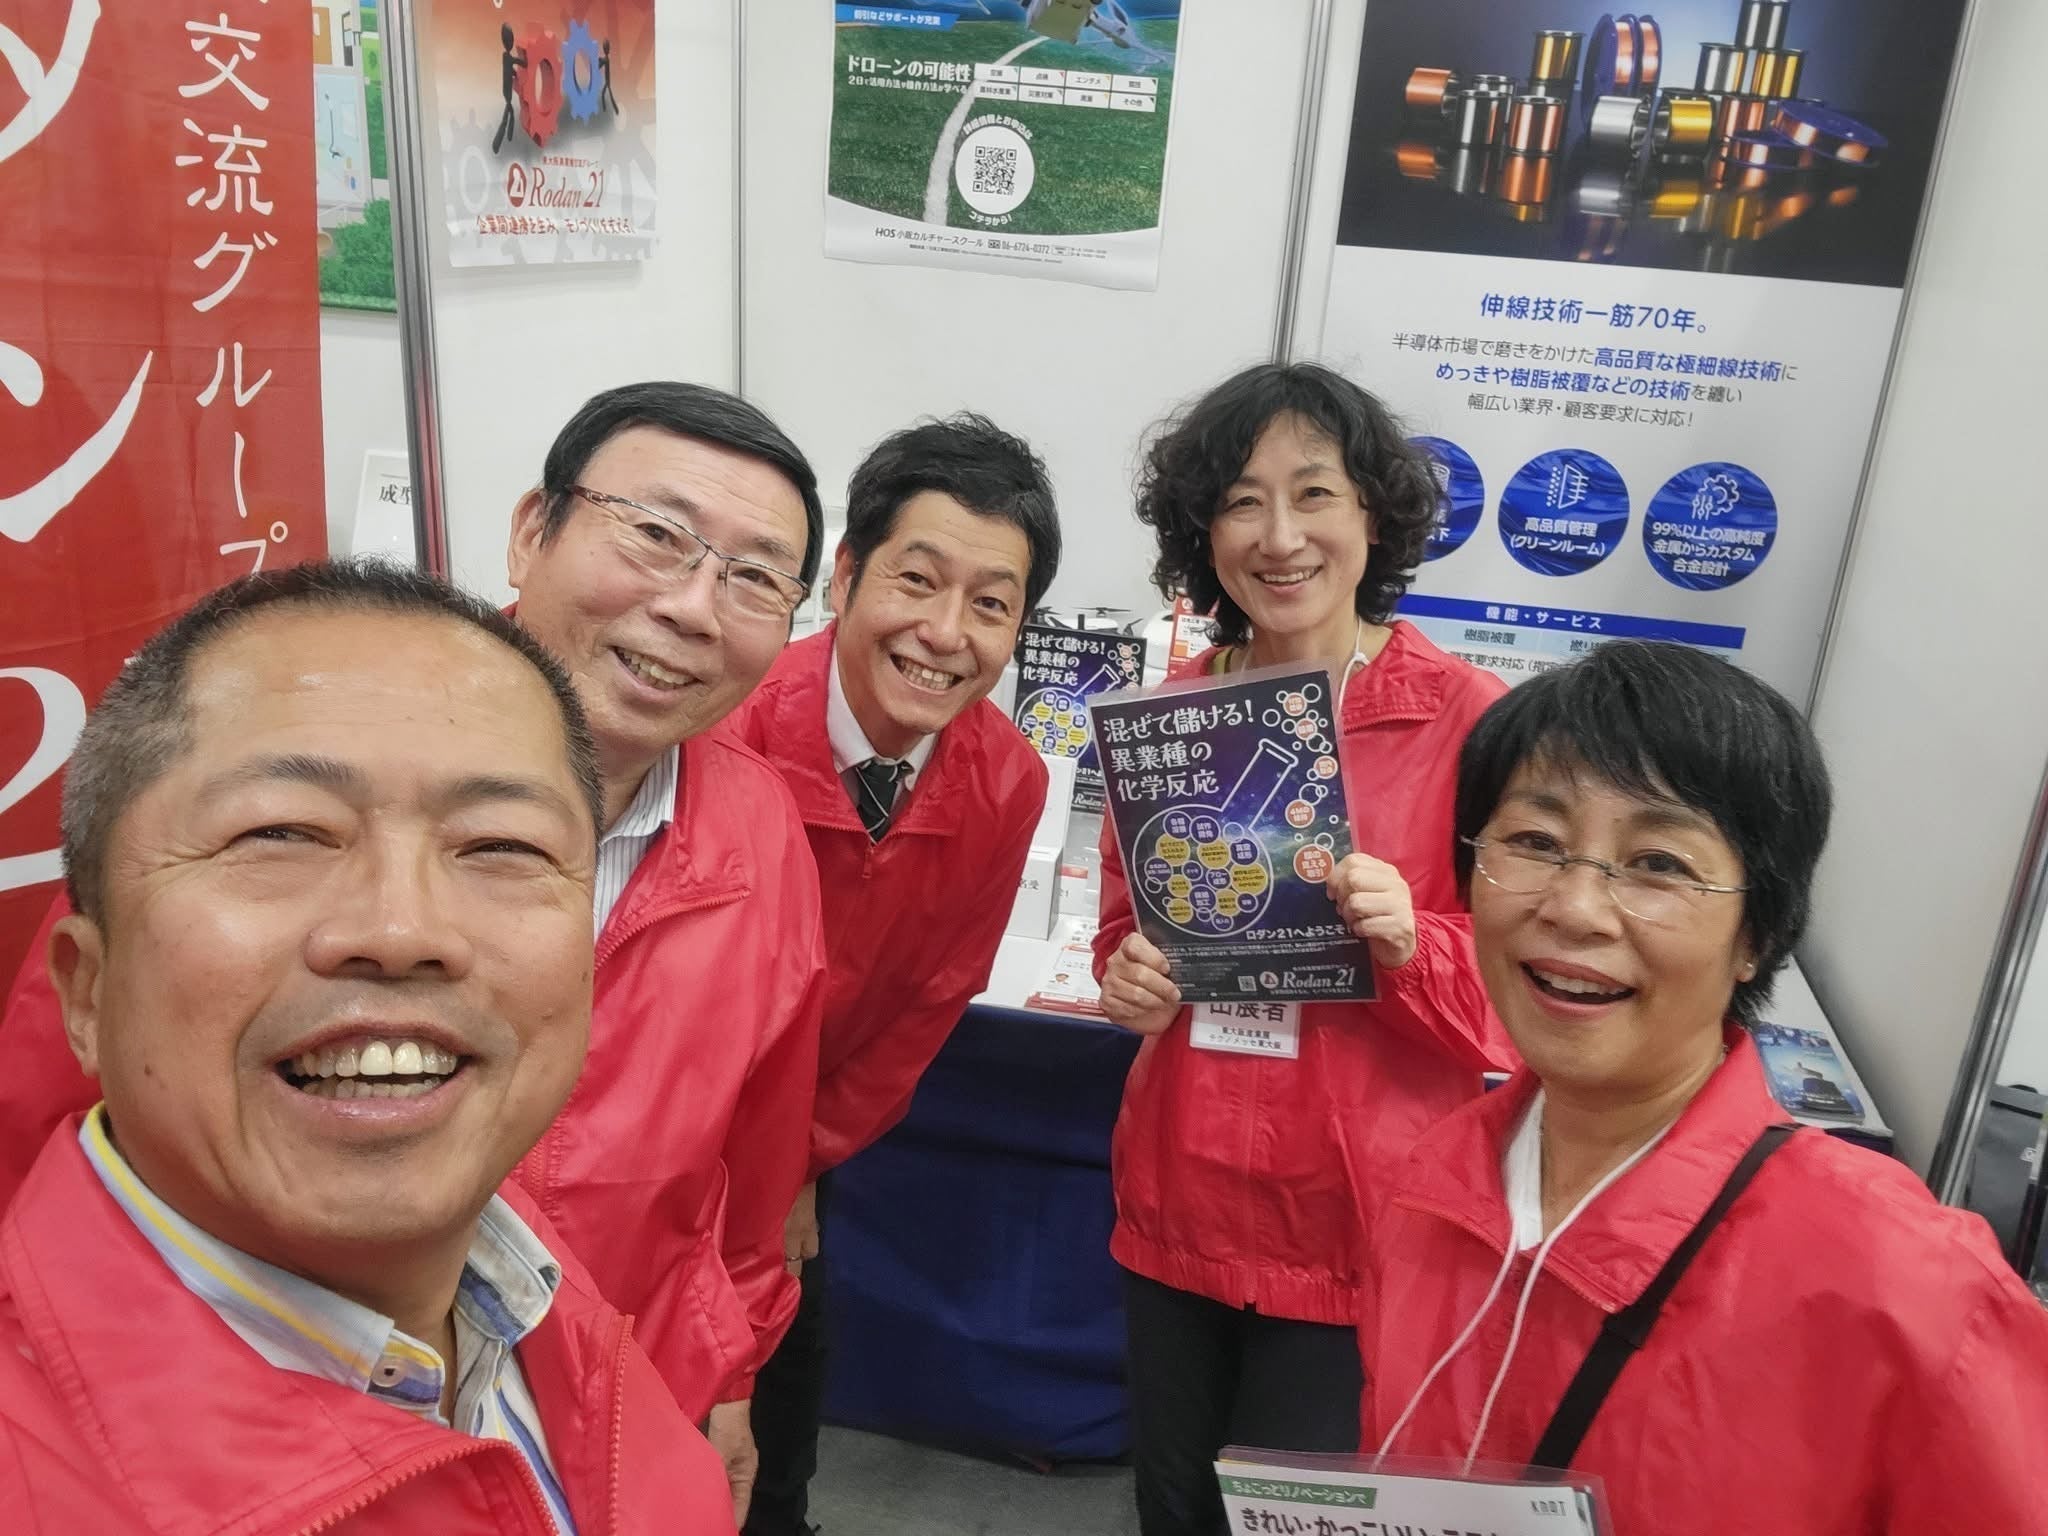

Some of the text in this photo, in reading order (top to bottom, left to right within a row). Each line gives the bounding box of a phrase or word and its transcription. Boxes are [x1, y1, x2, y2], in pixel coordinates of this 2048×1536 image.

[848, 54, 972, 83] ドローンの可能性
[528, 167, 605, 208] Rodan 21
[875, 227, 897, 239] HOS
[1480, 293, 1708, 336] 伸線技術一筋70年。
[1393, 332, 1798, 384] 半導体市場で磨きをかけた高品質な極細線技術に
[1436, 361, 1743, 404] めっきや樹脂被覆などの技術を纏い
[1525, 517, 1599, 538] 高品質管理
[1652, 522, 1766, 547] 99%以上の高純度
[1510, 534, 1606, 557] (クリーンルーム)
[1653, 540, 1756, 562] 金属からカスタム
[1673, 558, 1731, 577] 合金設計
[1486, 606, 1603, 631] 機能・サービス
[1025, 632, 1106, 656] 混ぜて儲ける!
[1464, 628, 1516, 646] 樹脂被覆
[1023, 650, 1080, 669] 異業種の
[1022, 666, 1079, 687] 化学反応
[1102, 698, 1255, 744] 混ぜて儲ける!
[1110, 742, 1213, 773] 異業種の
[1116, 769, 1219, 802] 化学反応
[1281, 967, 1356, 989] Rodan 21
